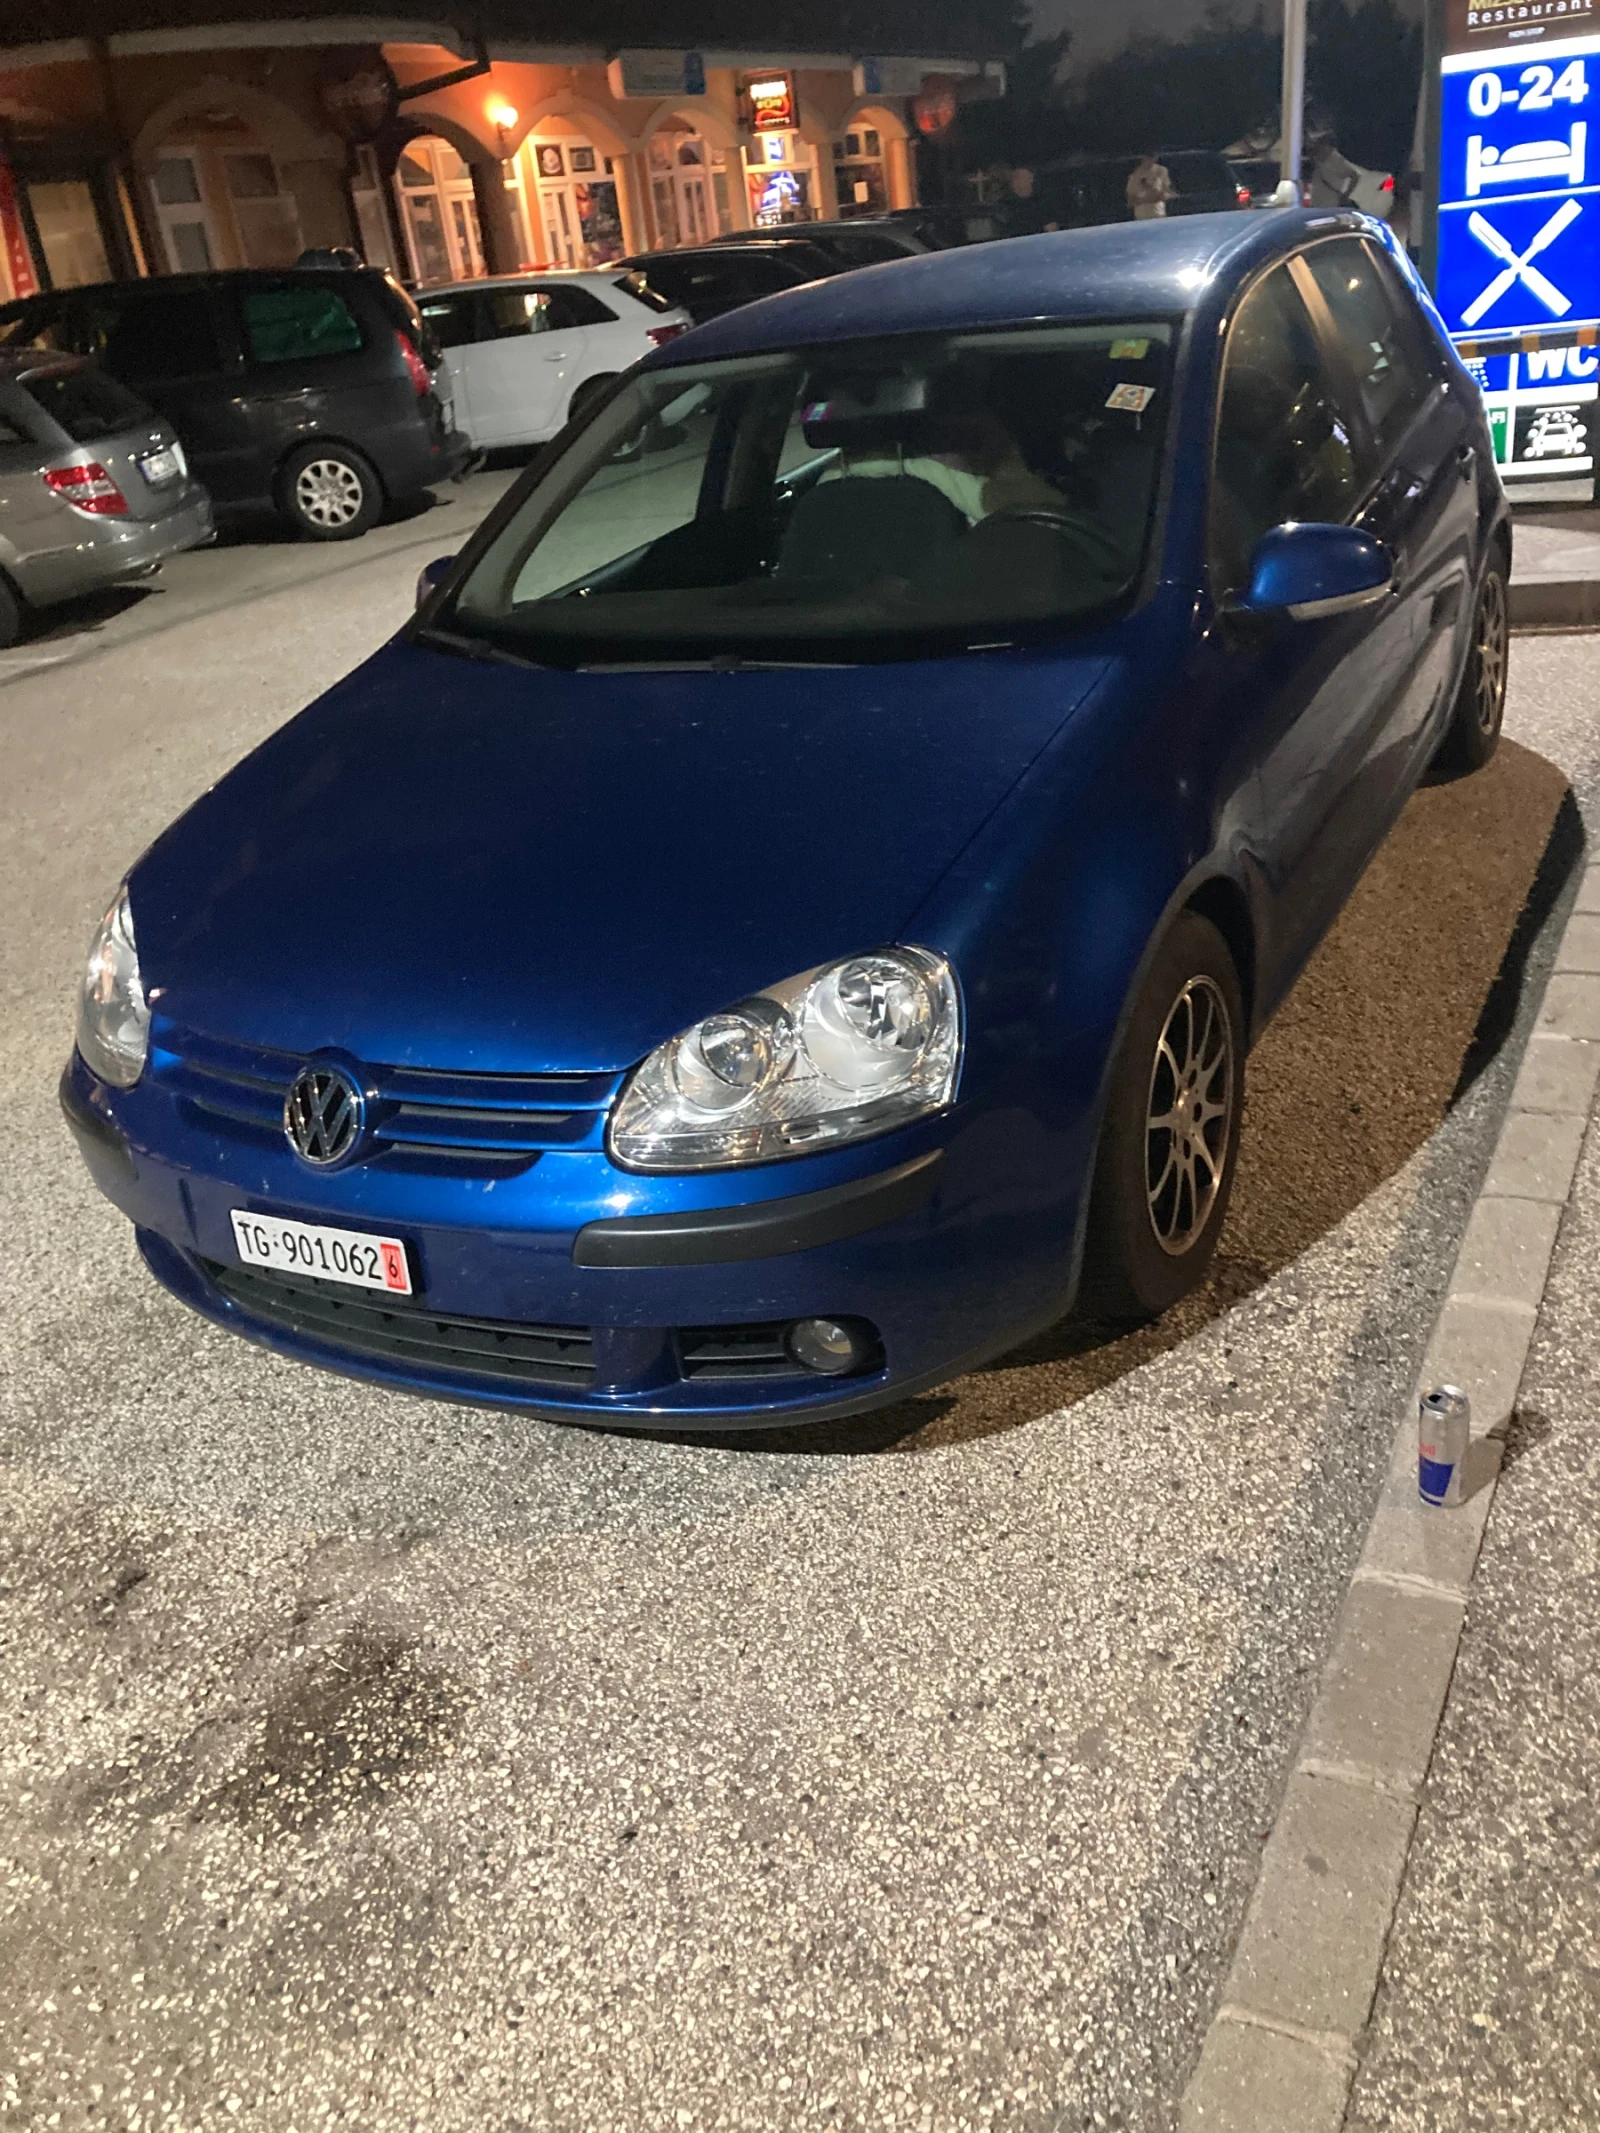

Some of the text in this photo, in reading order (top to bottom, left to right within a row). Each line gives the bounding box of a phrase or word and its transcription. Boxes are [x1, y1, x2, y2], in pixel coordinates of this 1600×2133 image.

[1467, 0, 1593, 26] Restaurant
[1468, 60, 1589, 117] 0-24
[1527, 346, 1599, 380] WC
[388, 1254, 399, 1279] 6
